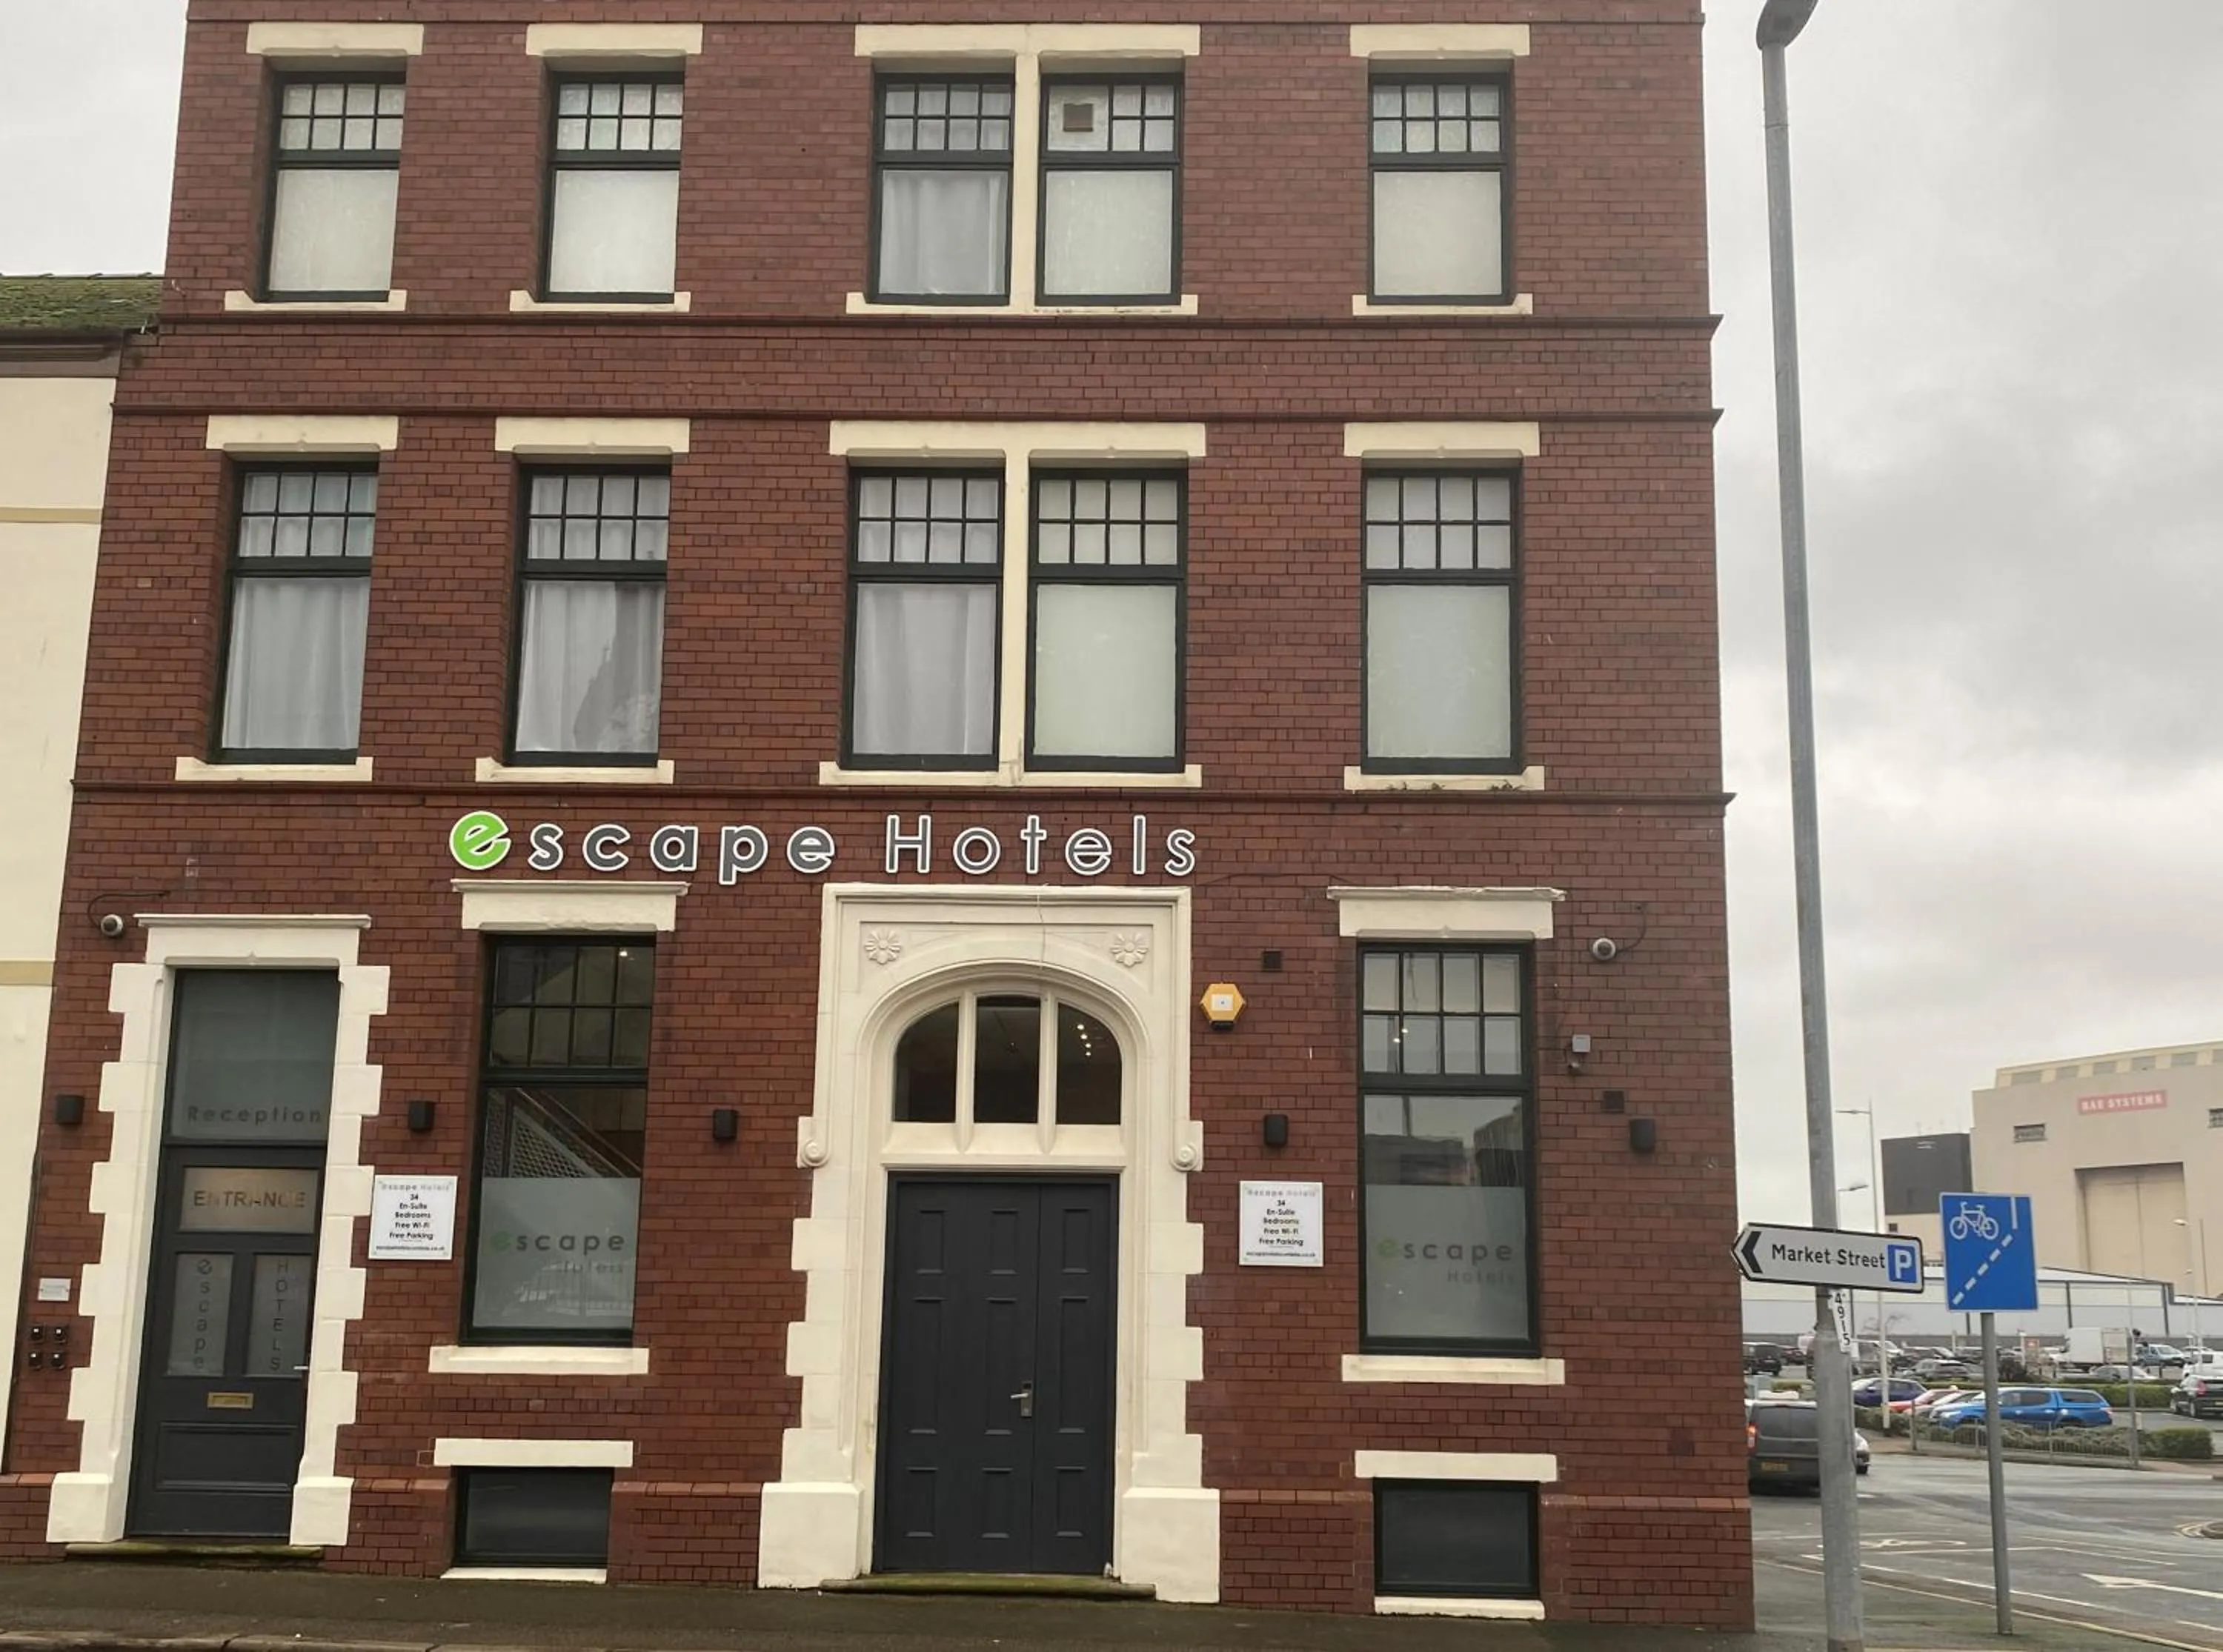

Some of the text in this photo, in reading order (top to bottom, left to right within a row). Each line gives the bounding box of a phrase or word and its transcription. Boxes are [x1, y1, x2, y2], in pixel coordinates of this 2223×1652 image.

[449, 810, 1196, 885] escape Hotels
[187, 1106, 322, 1126] Reception
[490, 1230, 625, 1256] escape
[1376, 1237, 1512, 1266] escape
[1772, 1244, 1913, 1279] Market Street P
[193, 1259, 213, 1369] escape
[270, 1260, 288, 1371] HOTELS
